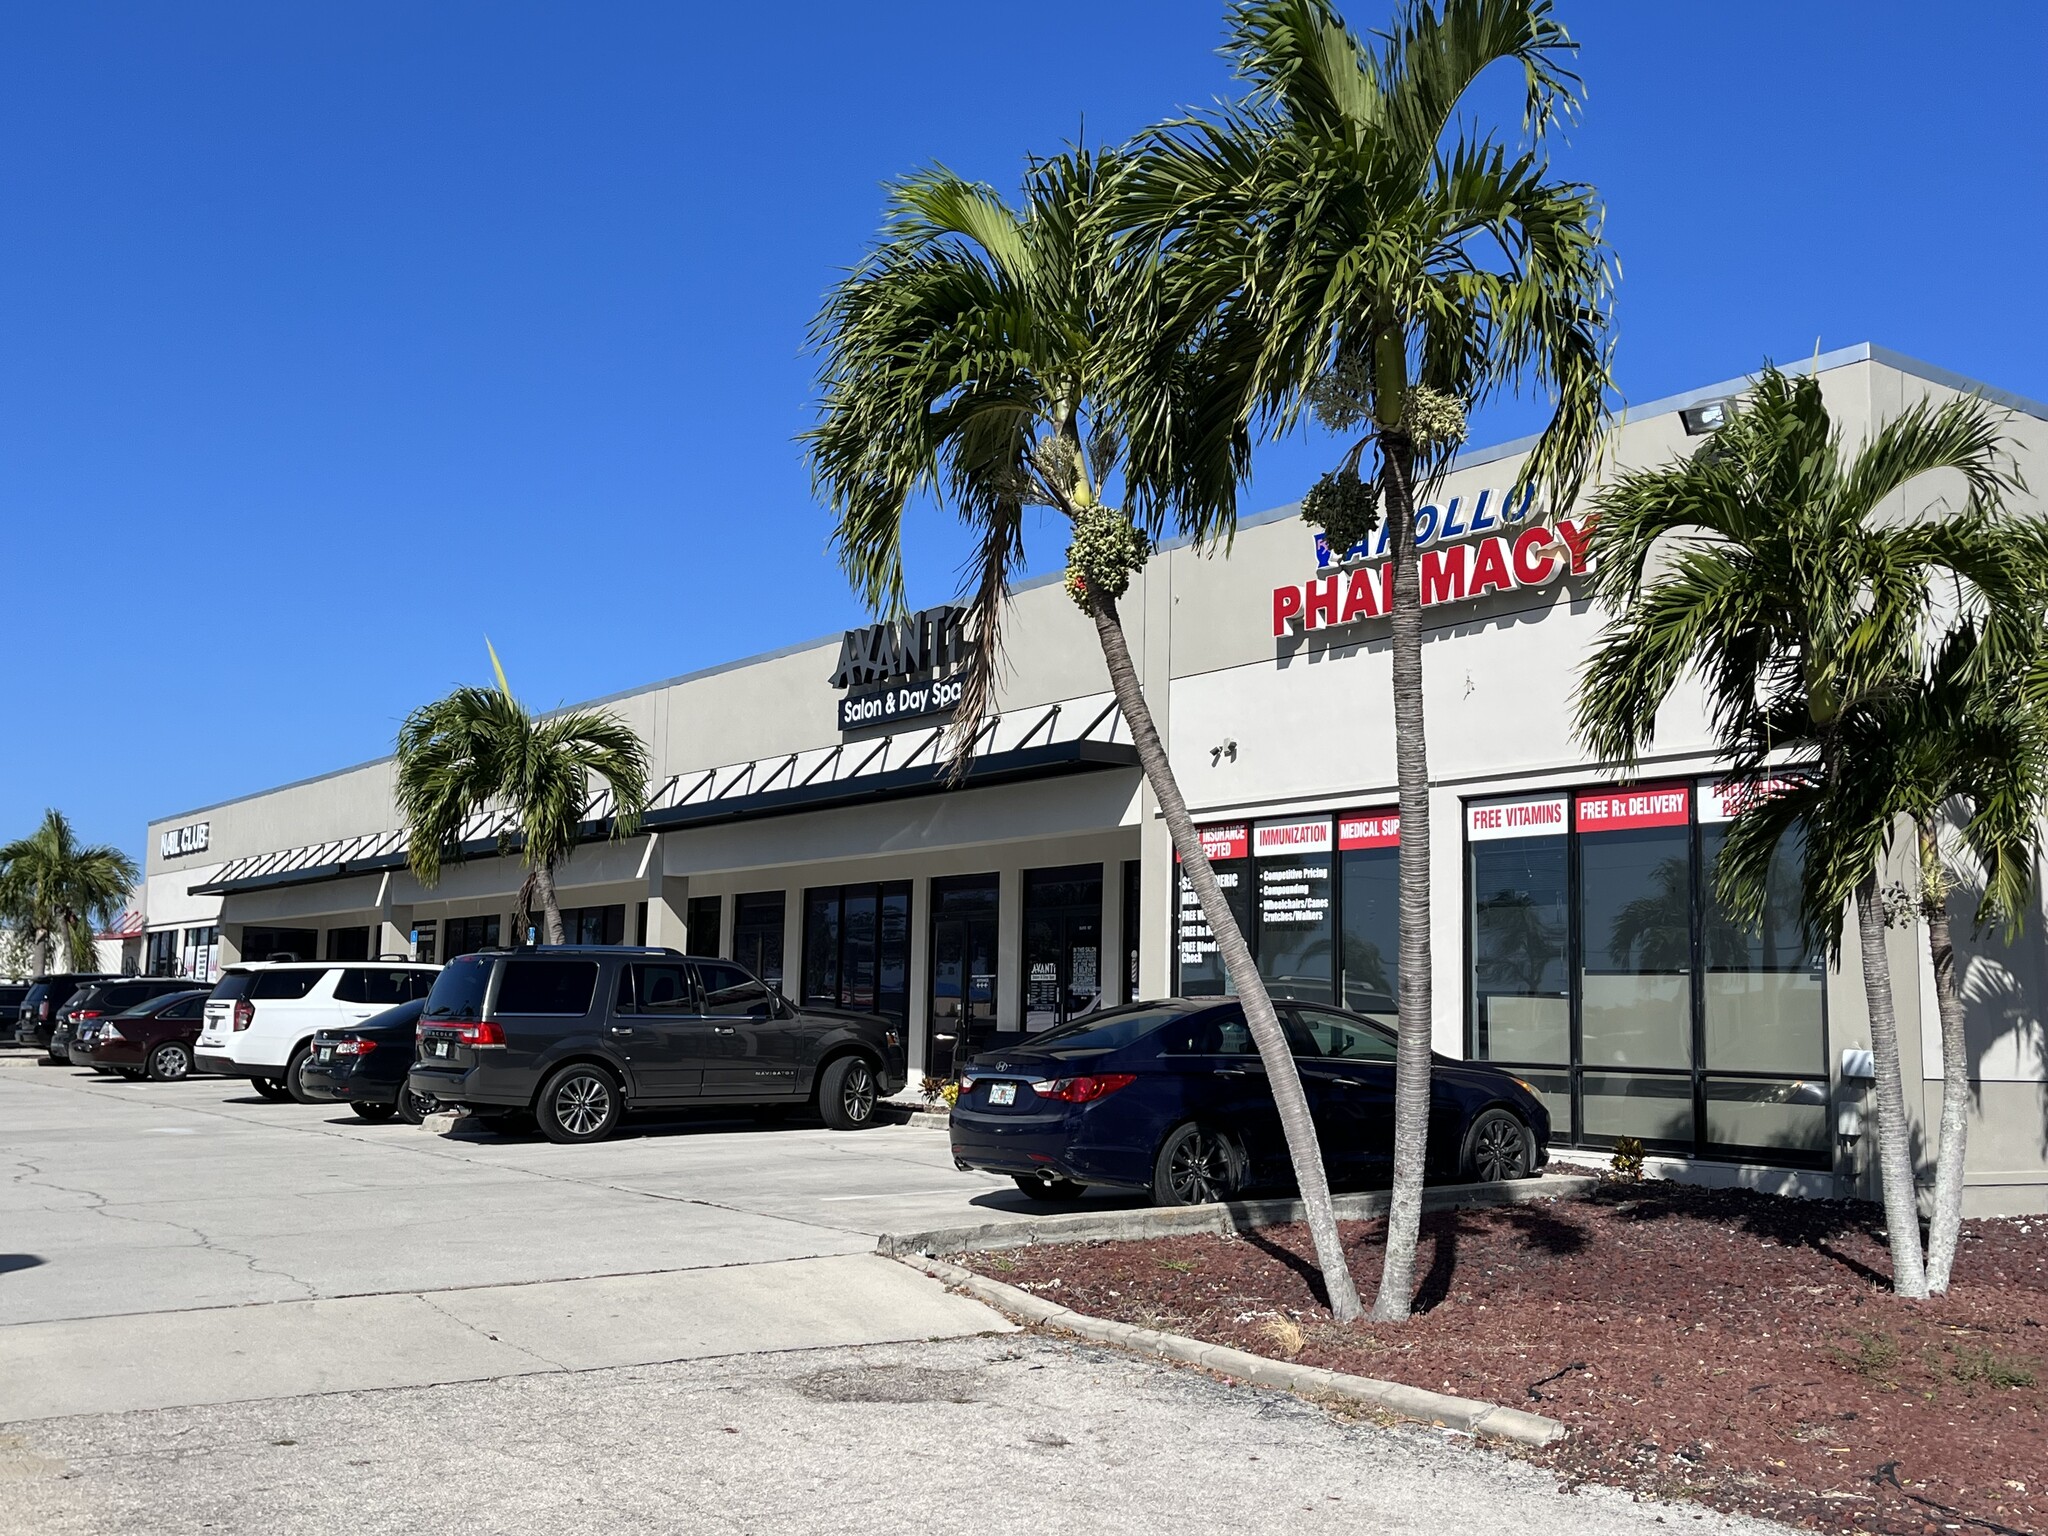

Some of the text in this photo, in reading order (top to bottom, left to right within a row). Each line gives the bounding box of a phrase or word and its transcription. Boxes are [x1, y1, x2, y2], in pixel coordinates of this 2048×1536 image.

[1343, 480, 1540, 563] AOLLO
[844, 681, 962, 723] Salon & Day Spa
[1473, 803, 1562, 830] FREE VITAMINS
[1580, 793, 1684, 820] FREE Rx DELIVERY
[161, 824, 209, 857] NAIL CLUB
[1203, 825, 1245, 842] INSURANCE
[1260, 825, 1327, 846] IMMUNIZATION
[1340, 821, 1380, 839] MEDICAL
[1203, 842, 1231, 858] CEPTED
